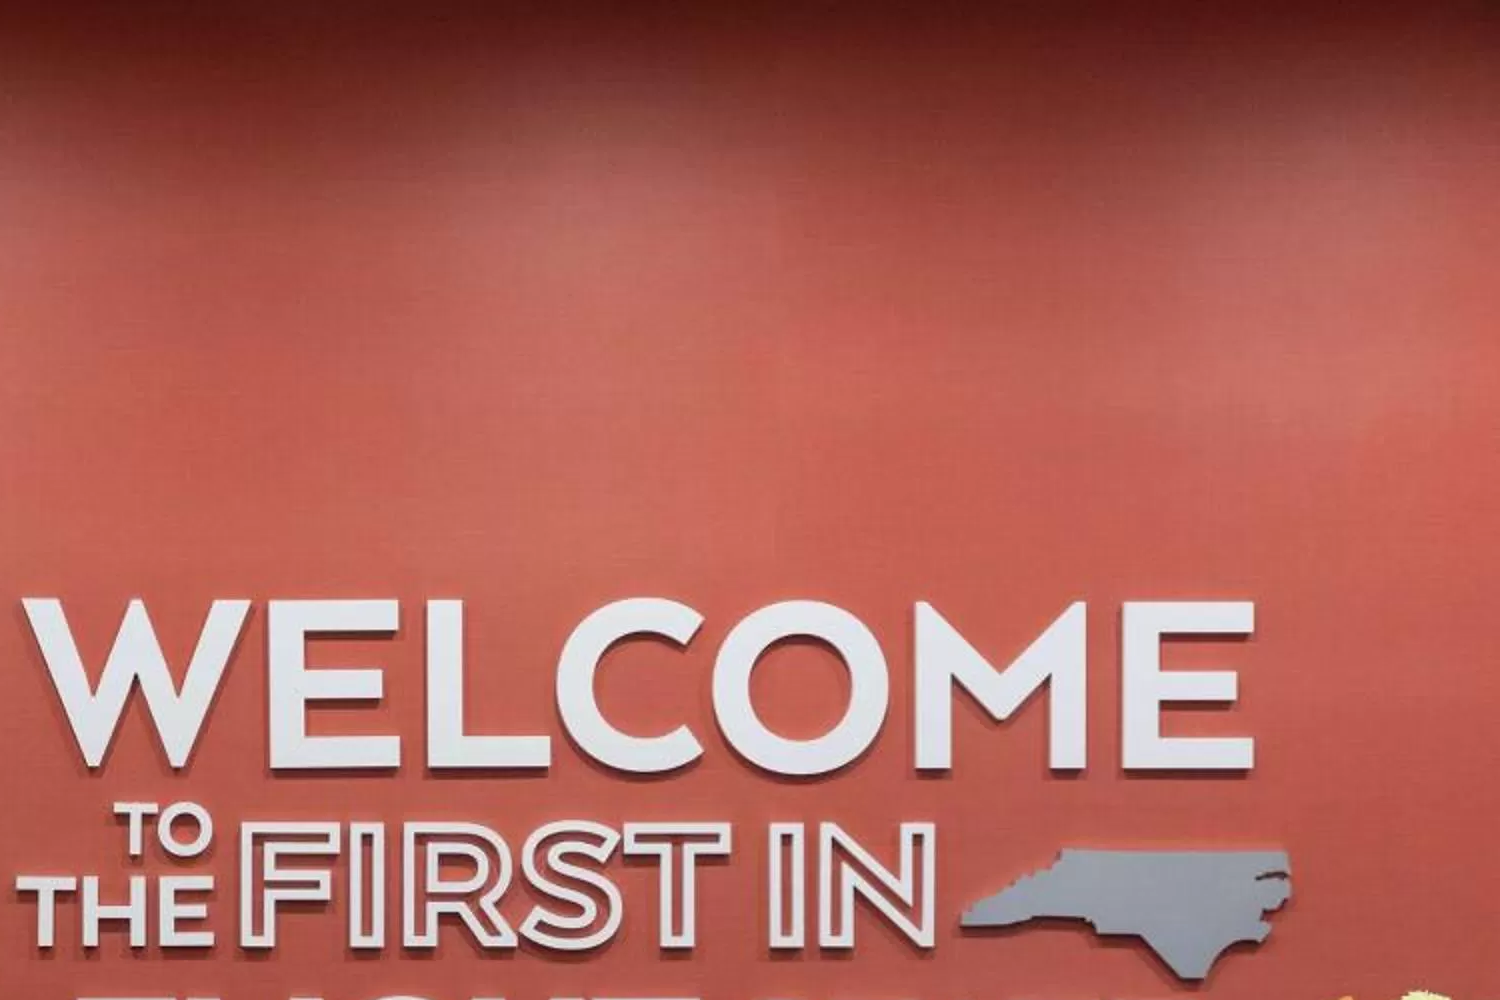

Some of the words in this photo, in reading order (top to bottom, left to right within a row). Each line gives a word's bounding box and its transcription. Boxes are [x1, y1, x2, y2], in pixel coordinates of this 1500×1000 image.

[22, 597, 1254, 774] WELCOME
[16, 875, 215, 948] THE
[239, 820, 732, 950] FIRST
[768, 822, 936, 949] IN
[113, 802, 213, 857] TO
